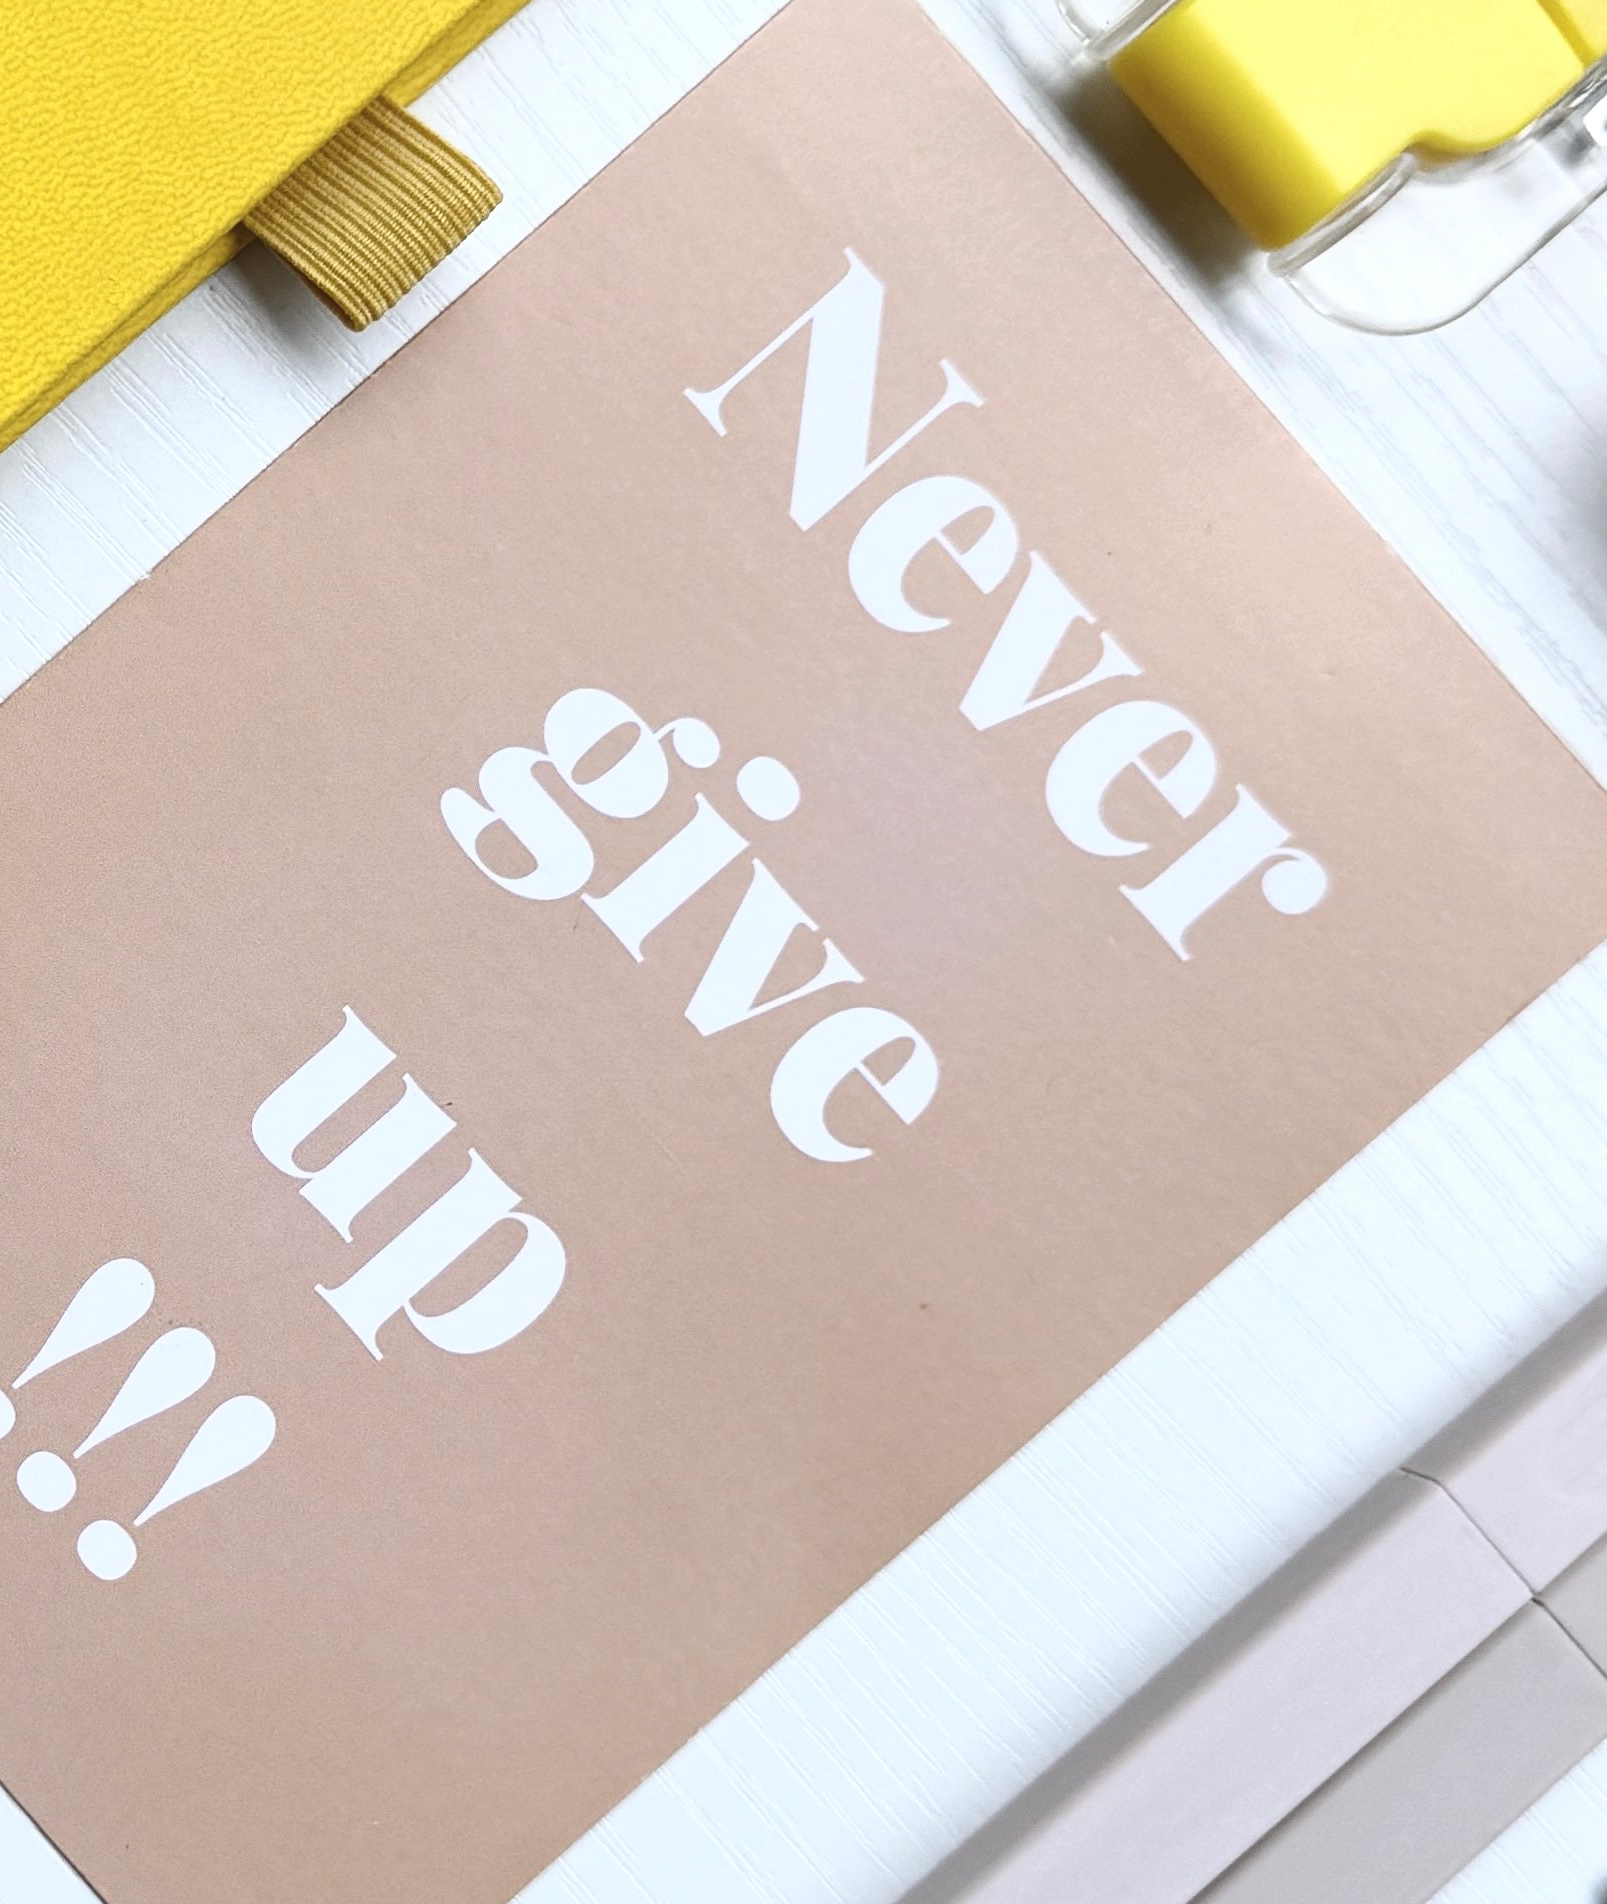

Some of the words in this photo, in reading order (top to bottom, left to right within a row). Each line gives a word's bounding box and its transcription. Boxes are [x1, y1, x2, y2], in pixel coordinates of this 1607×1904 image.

[682, 246, 1331, 962] Never
[439, 686, 940, 1163] give
[251, 1004, 567, 1362] up
